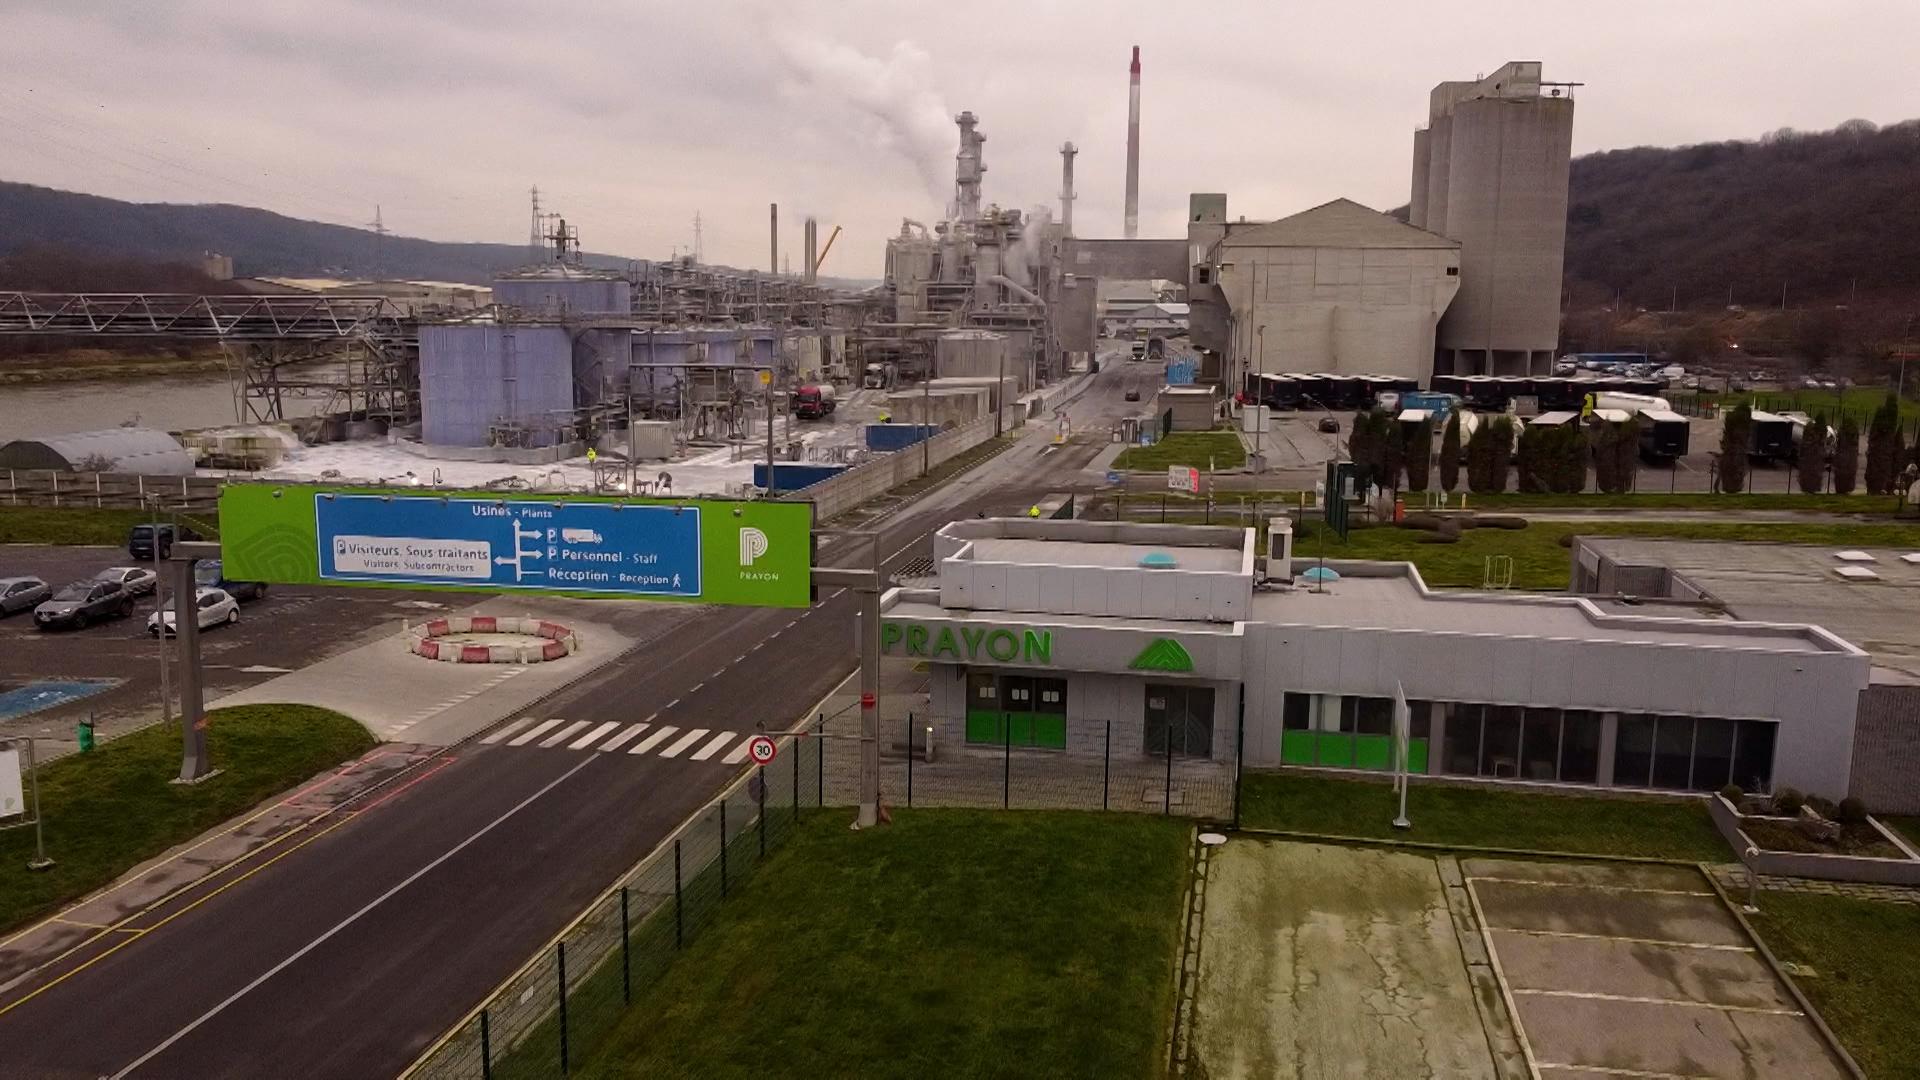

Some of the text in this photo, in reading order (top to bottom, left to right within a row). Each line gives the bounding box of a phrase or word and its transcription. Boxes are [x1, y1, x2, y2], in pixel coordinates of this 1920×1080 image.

[472, 505, 511, 516] Usines
[521, 508, 553, 518] Plants
[562, 549, 622, 562] Personnel
[633, 553, 658, 564] Staff
[548, 567, 609, 582] Réception
[620, 573, 669, 585] Reception
[740, 571, 779, 580] PRAYON
[881, 623, 1052, 664] PRAYON
[756, 745, 771, 756] 30
